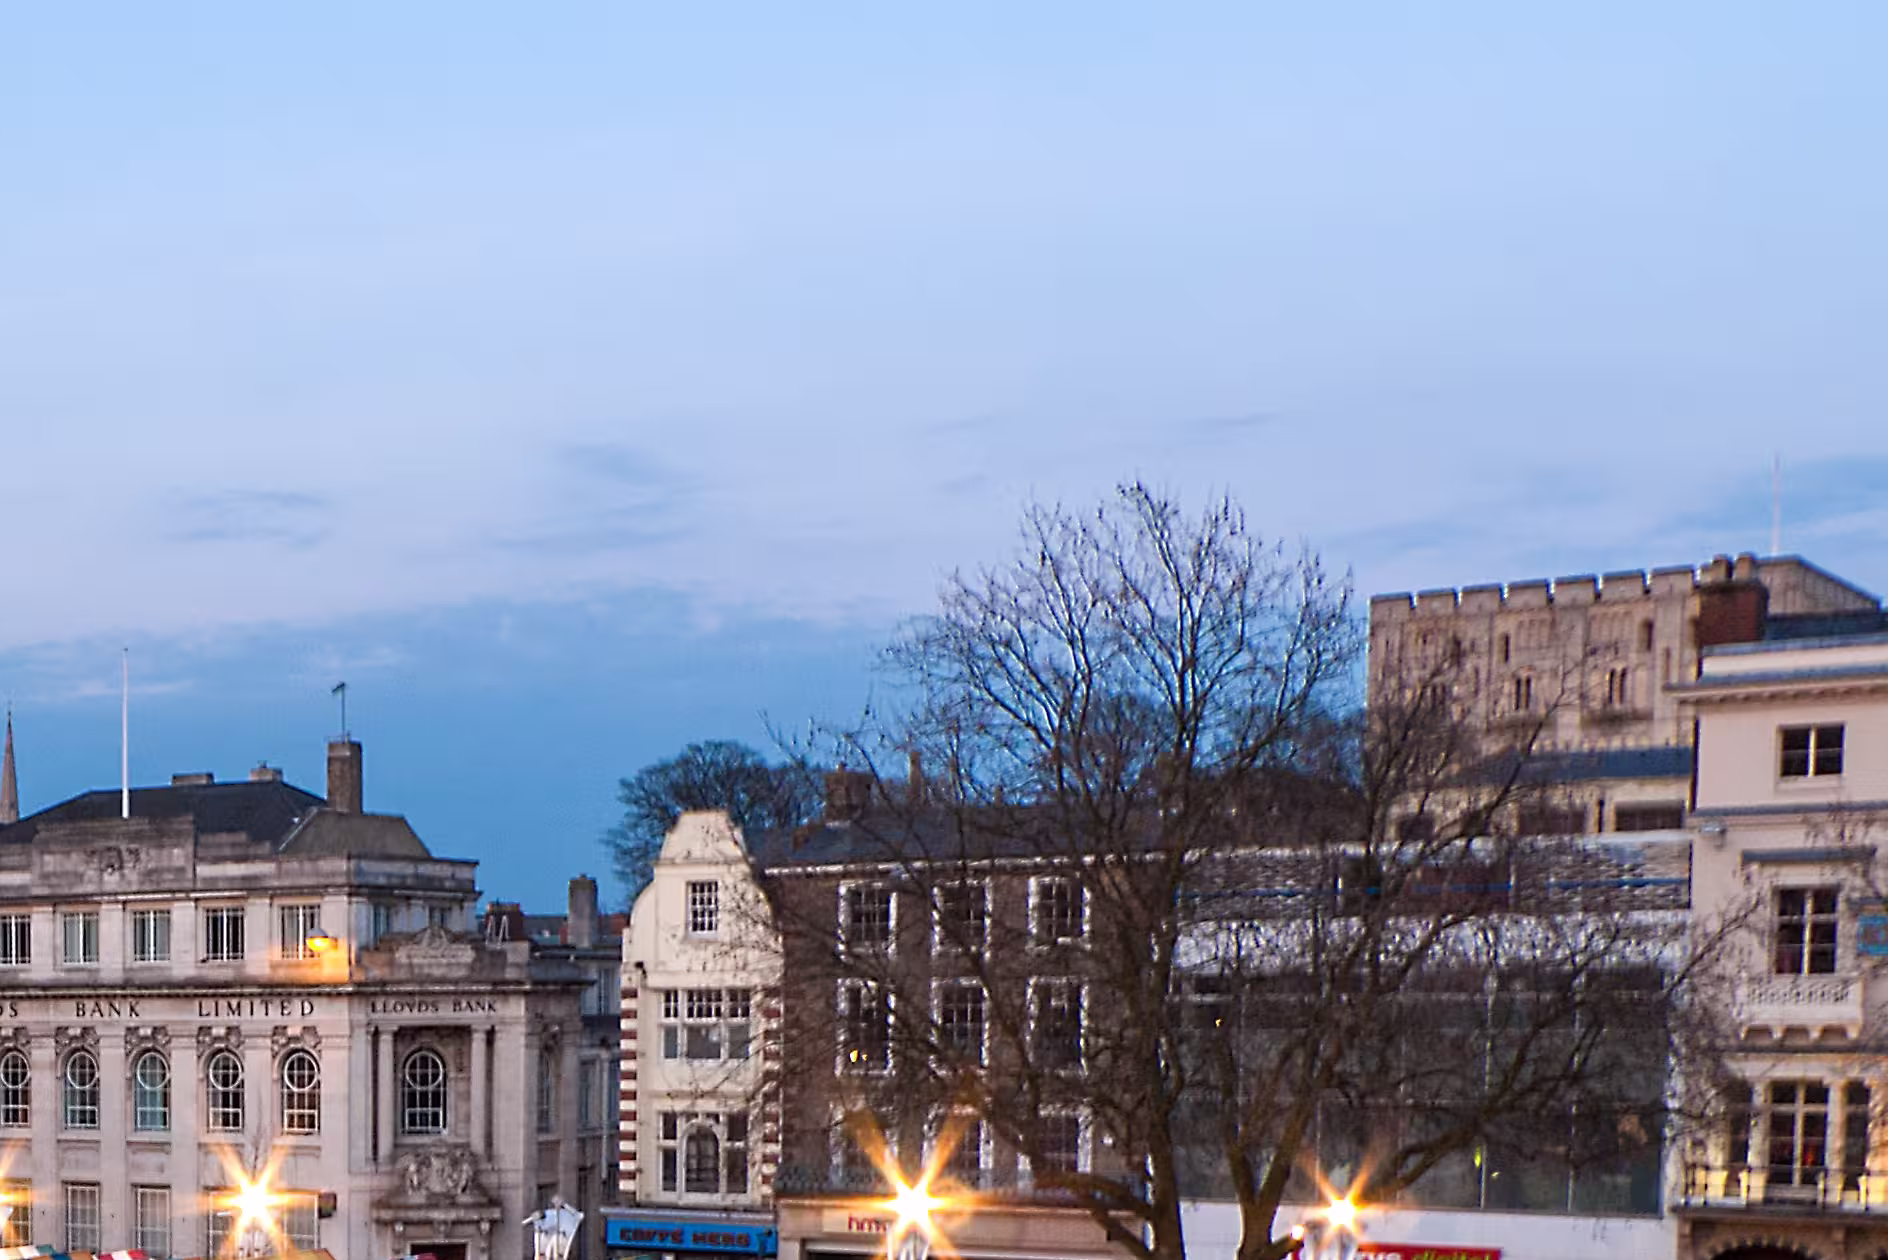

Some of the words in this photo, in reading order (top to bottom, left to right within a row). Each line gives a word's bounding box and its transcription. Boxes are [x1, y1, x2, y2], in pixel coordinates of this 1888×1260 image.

[75, 1001, 140, 1018] BANK
[198, 1000, 314, 1018] LIMITED
[370, 1000, 439, 1014] LLOYDS
[452, 1000, 496, 1014] BANK
